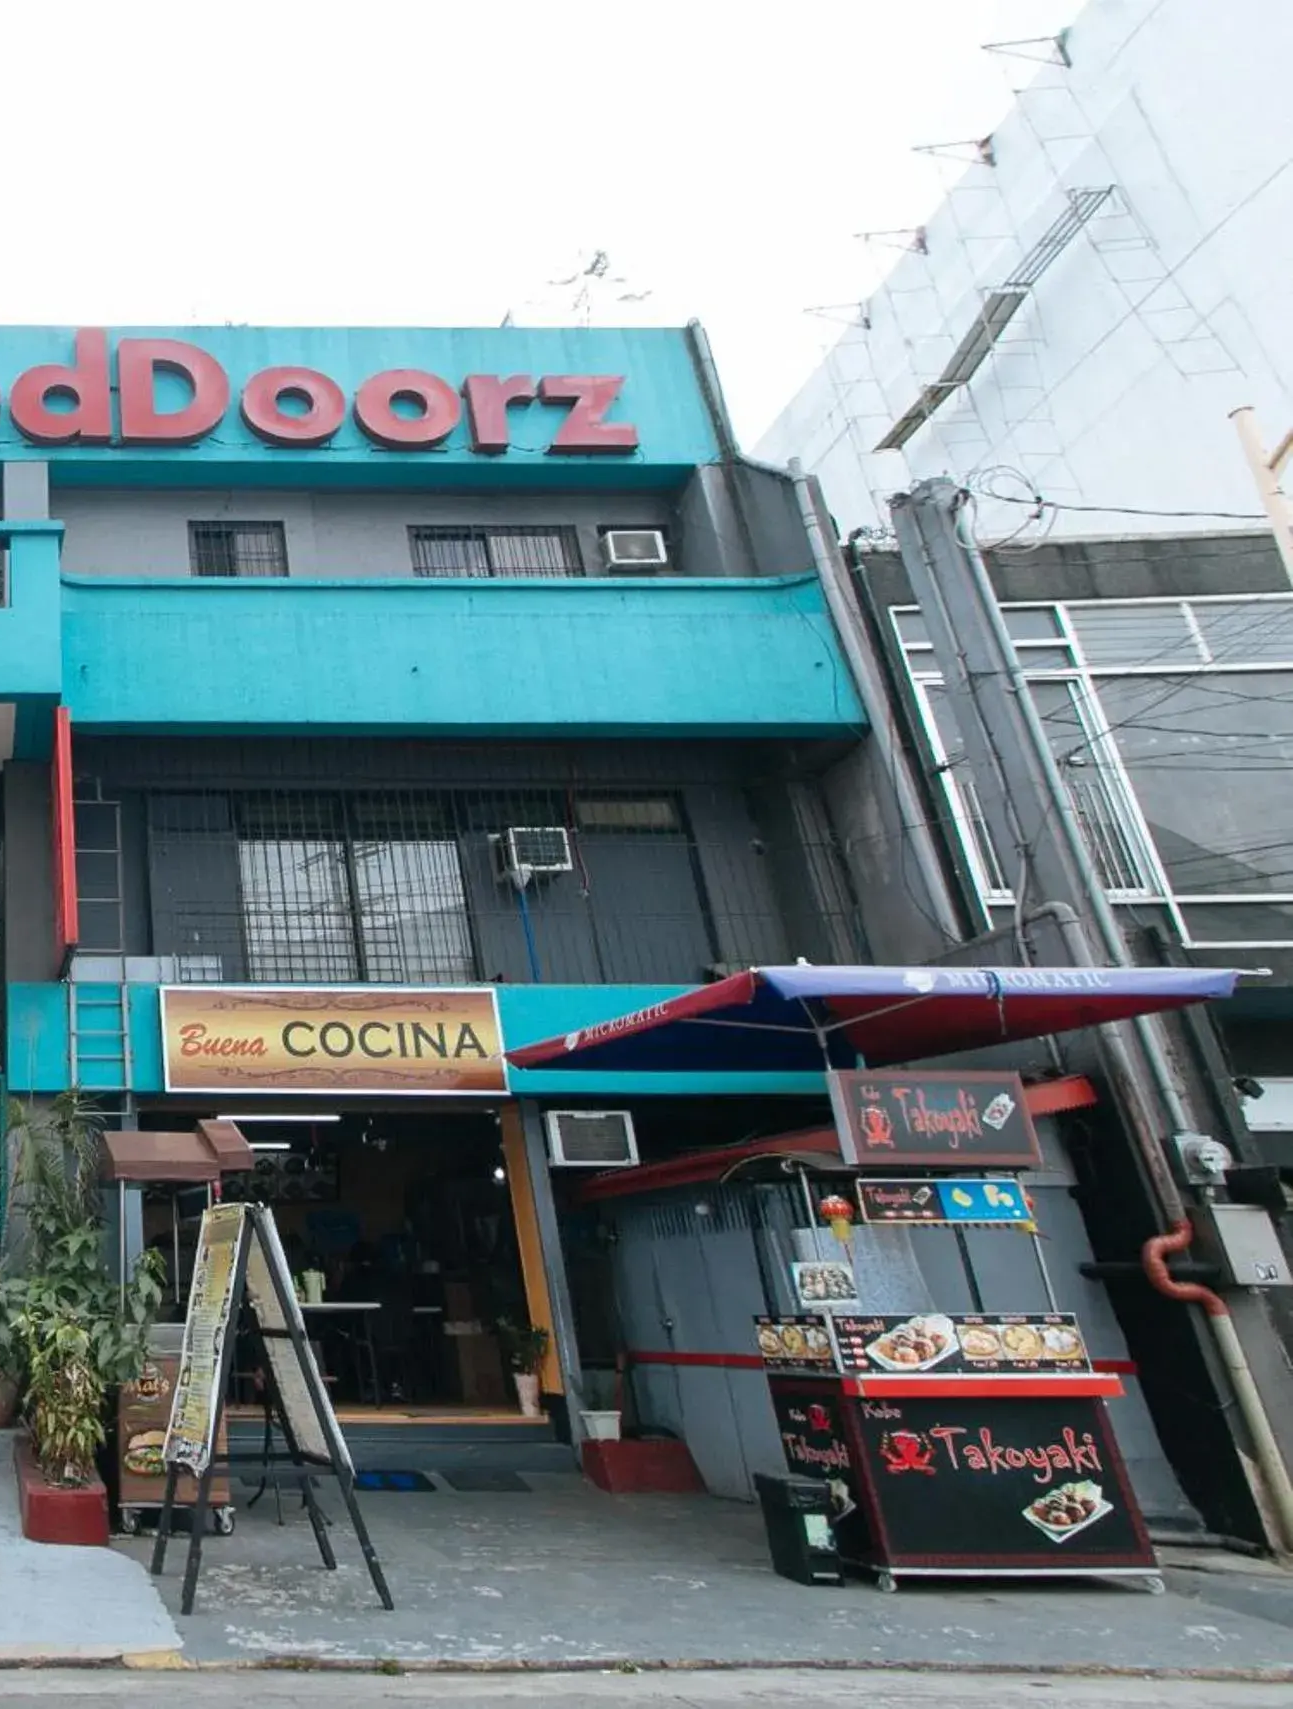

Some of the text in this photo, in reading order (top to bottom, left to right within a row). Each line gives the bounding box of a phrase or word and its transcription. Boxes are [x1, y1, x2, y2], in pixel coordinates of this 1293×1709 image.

[943, 971, 1111, 988] MICOMATIC
[179, 1020, 489, 1059] Buena COCINA
[583, 1004, 669, 1042] MICROMATIC
[891, 1087, 984, 1149] Takoyaki
[929, 1426, 1103, 1484] Takoyaki
